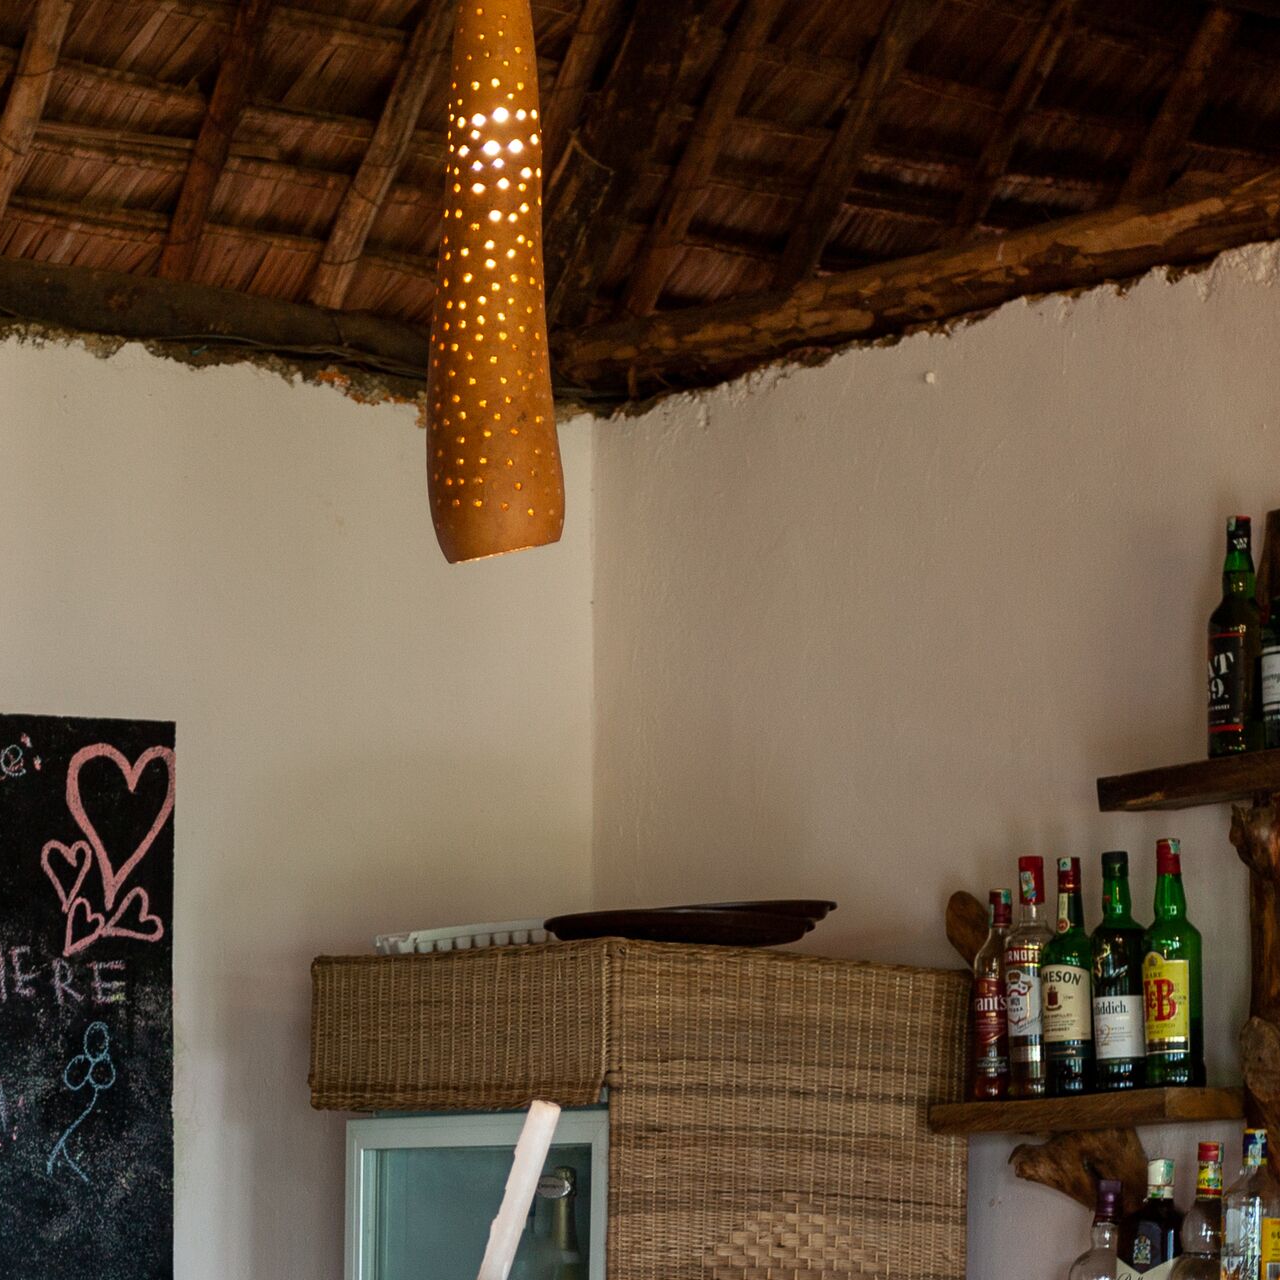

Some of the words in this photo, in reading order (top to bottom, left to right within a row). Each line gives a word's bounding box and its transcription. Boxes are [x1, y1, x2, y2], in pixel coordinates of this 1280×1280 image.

[1007, 949, 1041, 962] RNOFF
[1042, 970, 1081, 986] MESON
[974, 994, 1008, 1012] rant's
